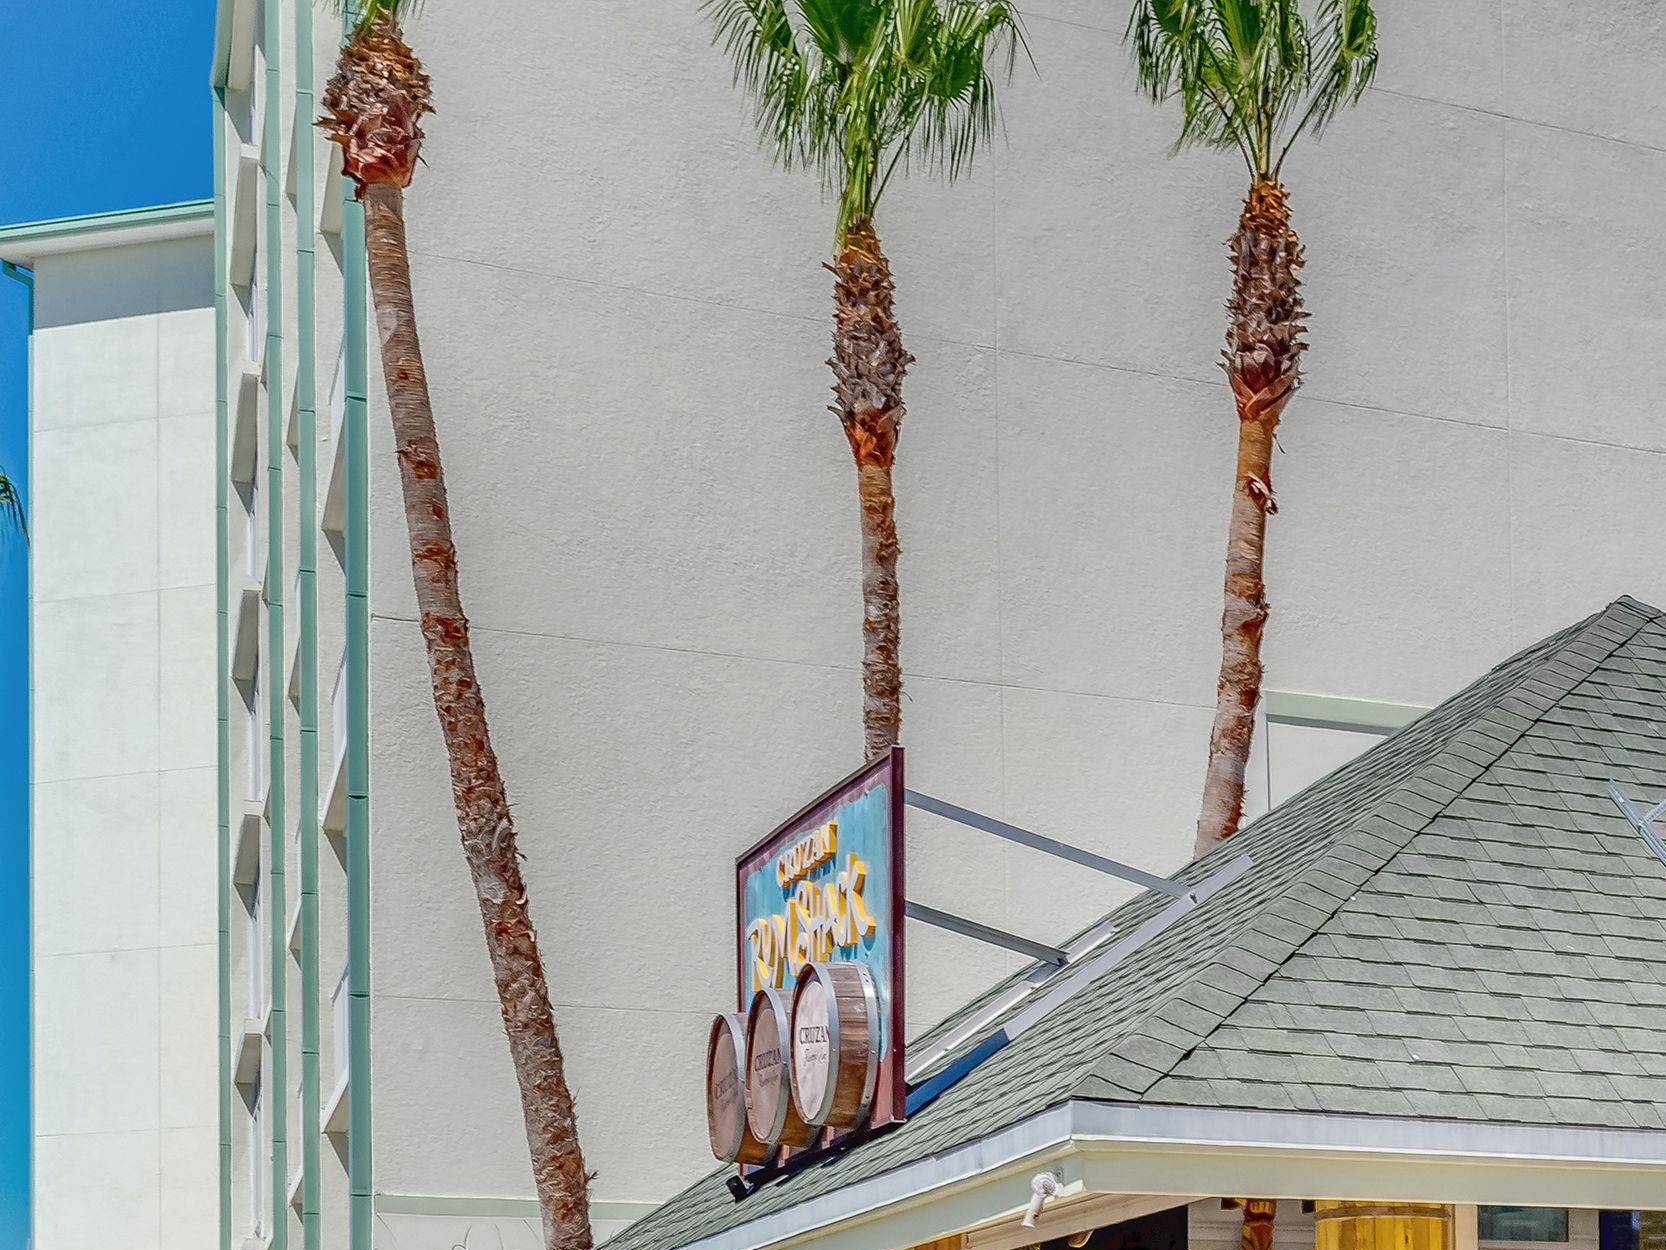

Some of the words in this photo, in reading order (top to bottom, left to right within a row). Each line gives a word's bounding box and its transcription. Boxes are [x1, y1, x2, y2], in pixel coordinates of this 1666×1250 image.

[776, 820, 838, 888] CRUZAN
[746, 898, 801, 992] RUM
[795, 852, 877, 964] SHACK
